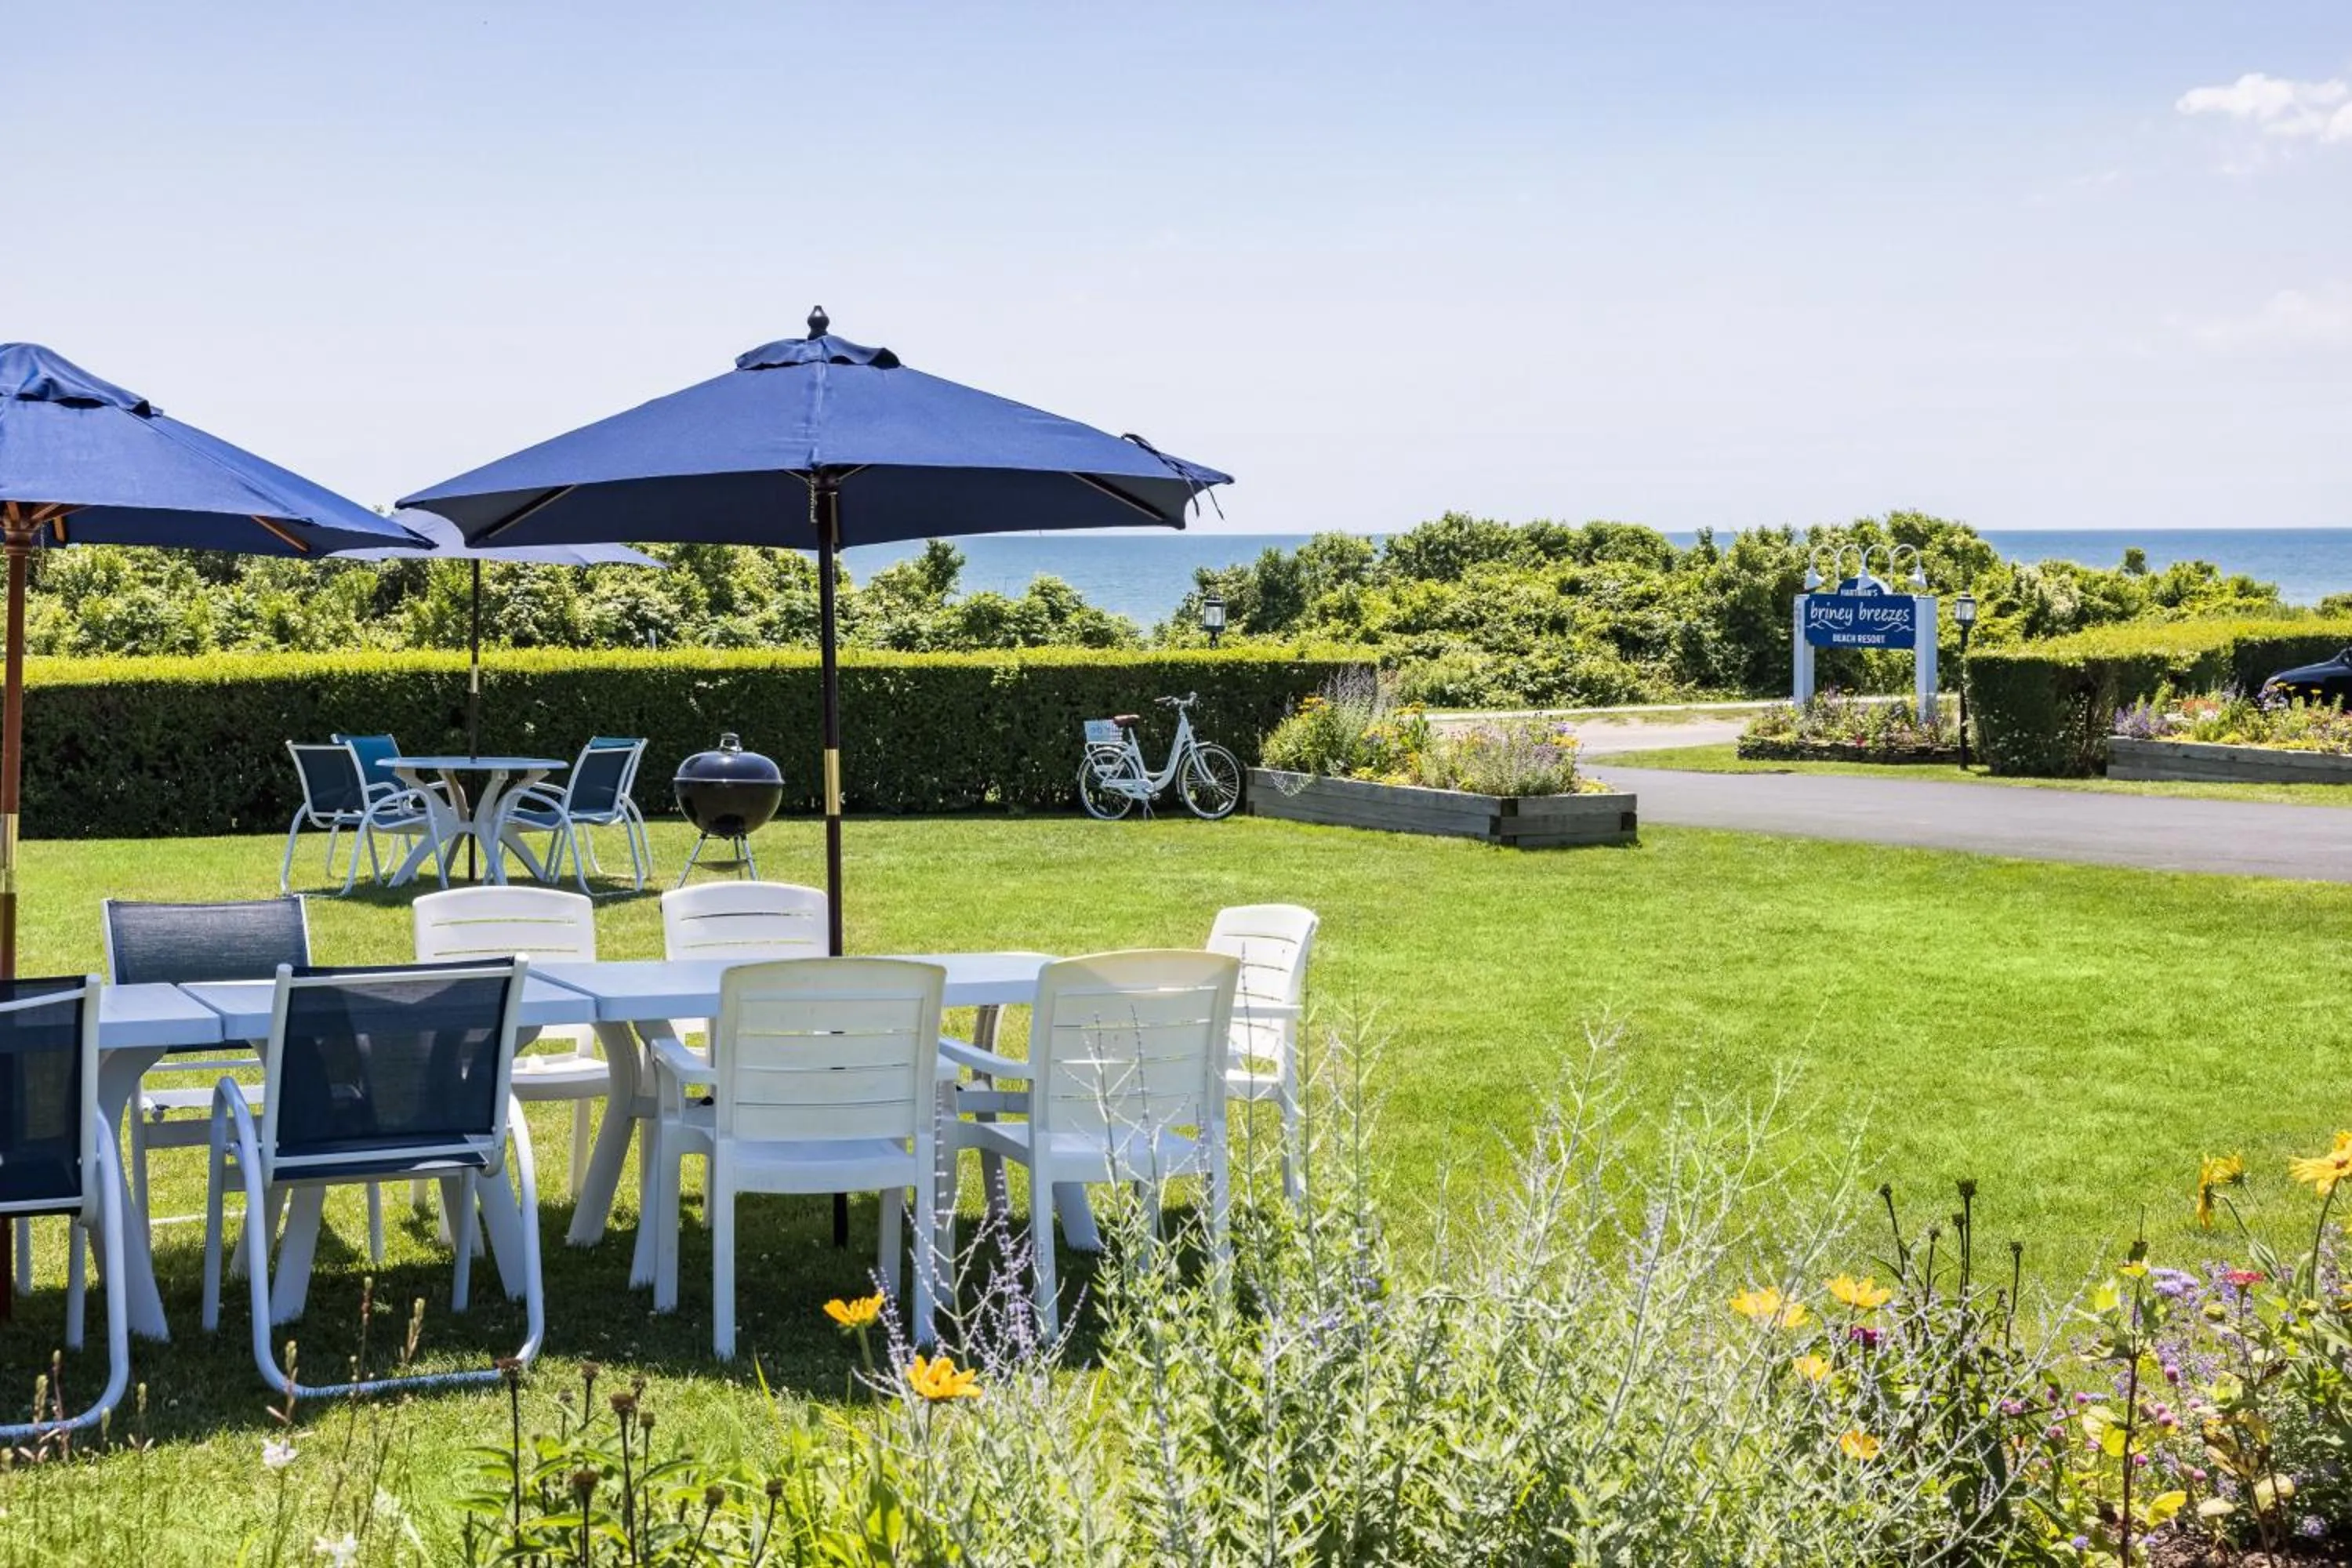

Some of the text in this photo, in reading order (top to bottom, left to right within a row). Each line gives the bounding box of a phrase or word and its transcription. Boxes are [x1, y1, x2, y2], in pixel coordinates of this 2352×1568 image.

[1810, 601, 1853, 626] briney
[1859, 601, 1910, 622] breezes
[1832, 633, 1886, 644] BEACH RESORT
